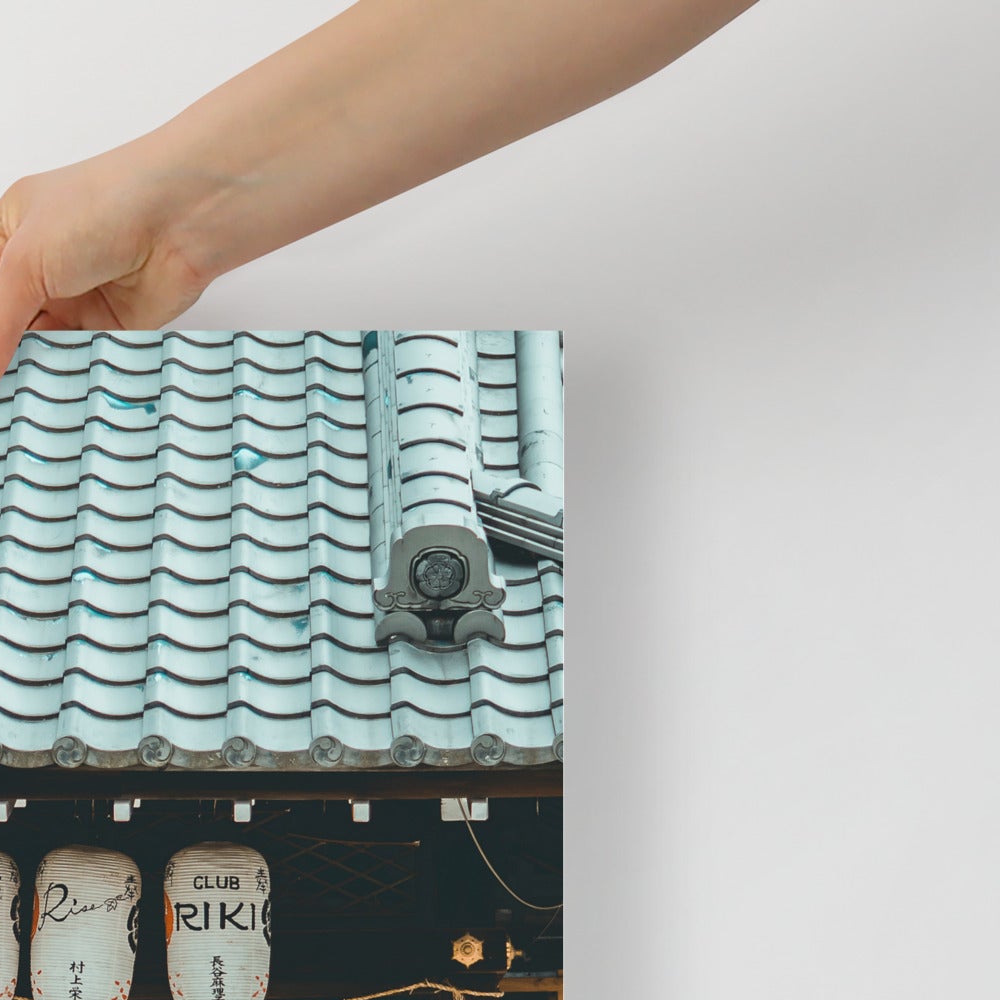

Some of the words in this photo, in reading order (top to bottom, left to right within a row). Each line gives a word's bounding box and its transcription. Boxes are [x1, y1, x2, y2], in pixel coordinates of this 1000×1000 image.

[193, 875, 241, 892] CLUB
[38, 882, 103, 931] Rise
[174, 901, 257, 932] RIKI
